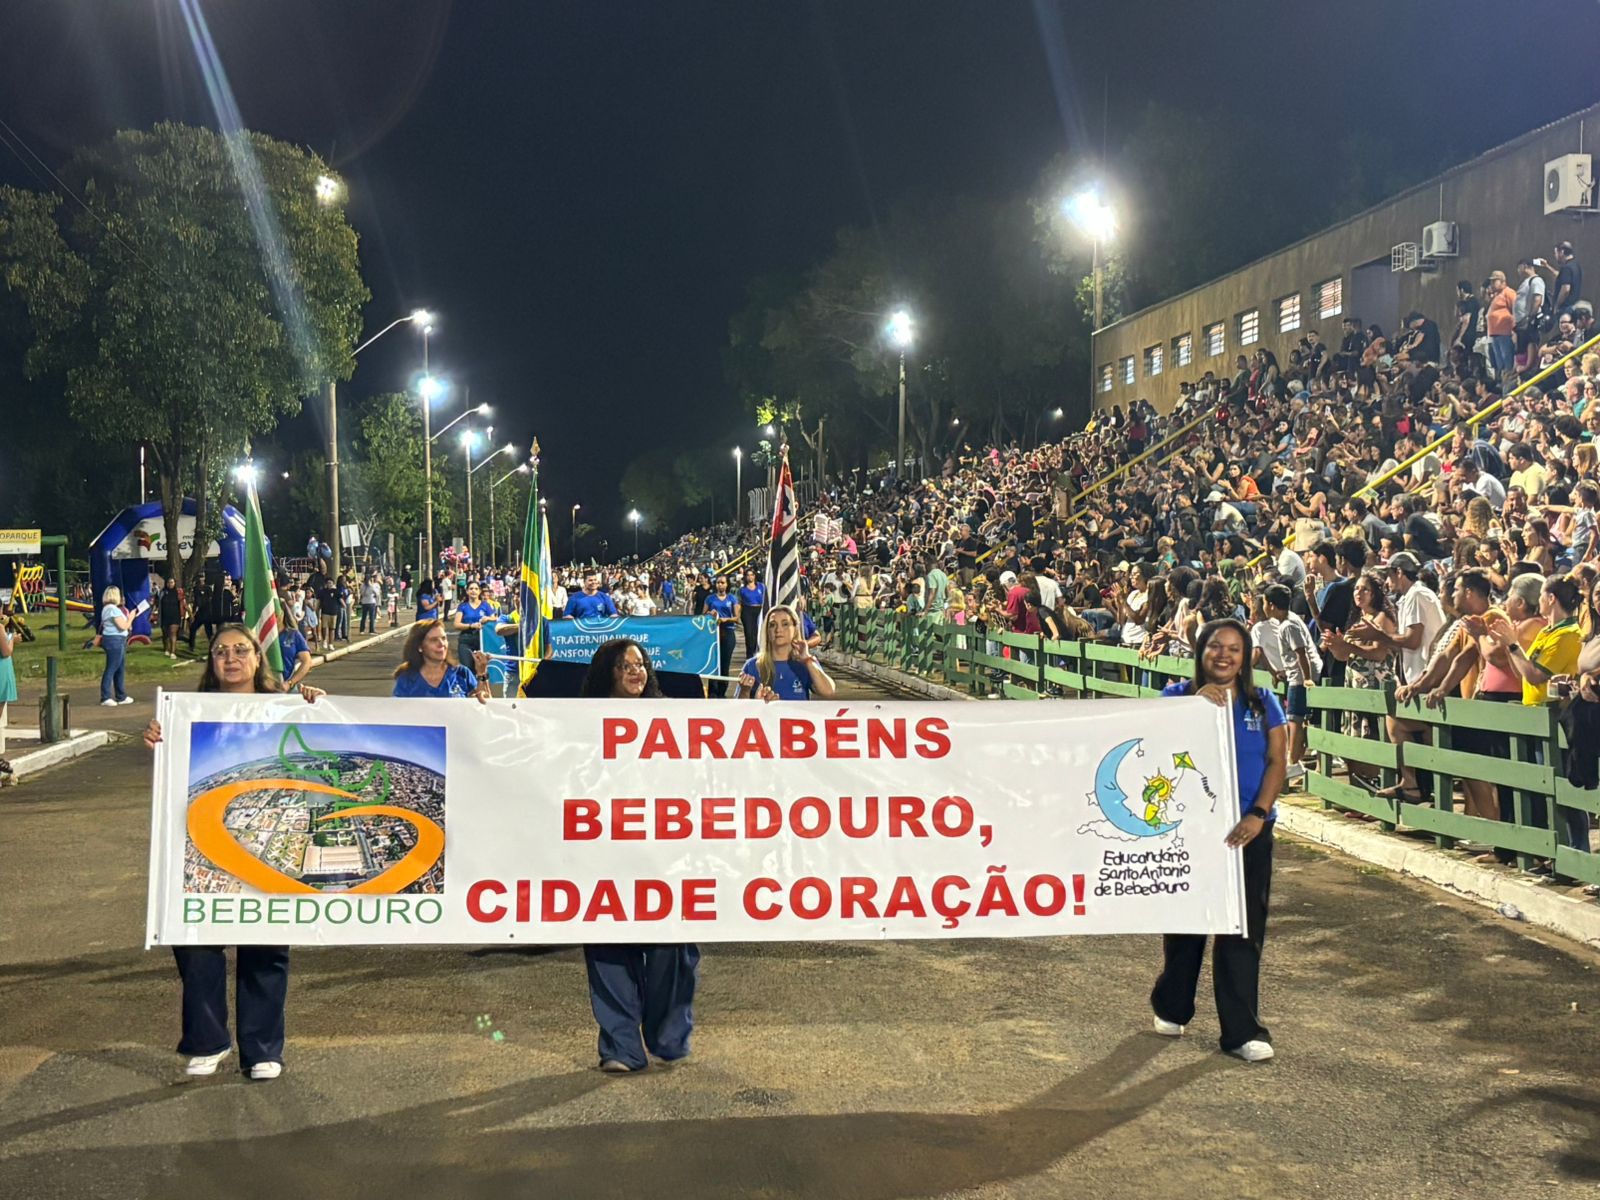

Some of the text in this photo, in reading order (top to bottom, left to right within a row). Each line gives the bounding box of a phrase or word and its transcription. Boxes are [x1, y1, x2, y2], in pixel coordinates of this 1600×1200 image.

[629, 633, 649, 643] QUE
[644, 646, 661, 656] UE
[603, 708, 952, 760] PARABÉNS
[563, 796, 993, 848] BEBEDOURO,
[1104, 847, 1189, 866] Educandário
[1099, 864, 1190, 881] Santo Antonio
[466, 865, 1087, 929] CIDADE CORAÇÃO!
[1094, 881, 1189, 896] de Bebedouro
[183, 898, 443, 924] BEBEDOURO
